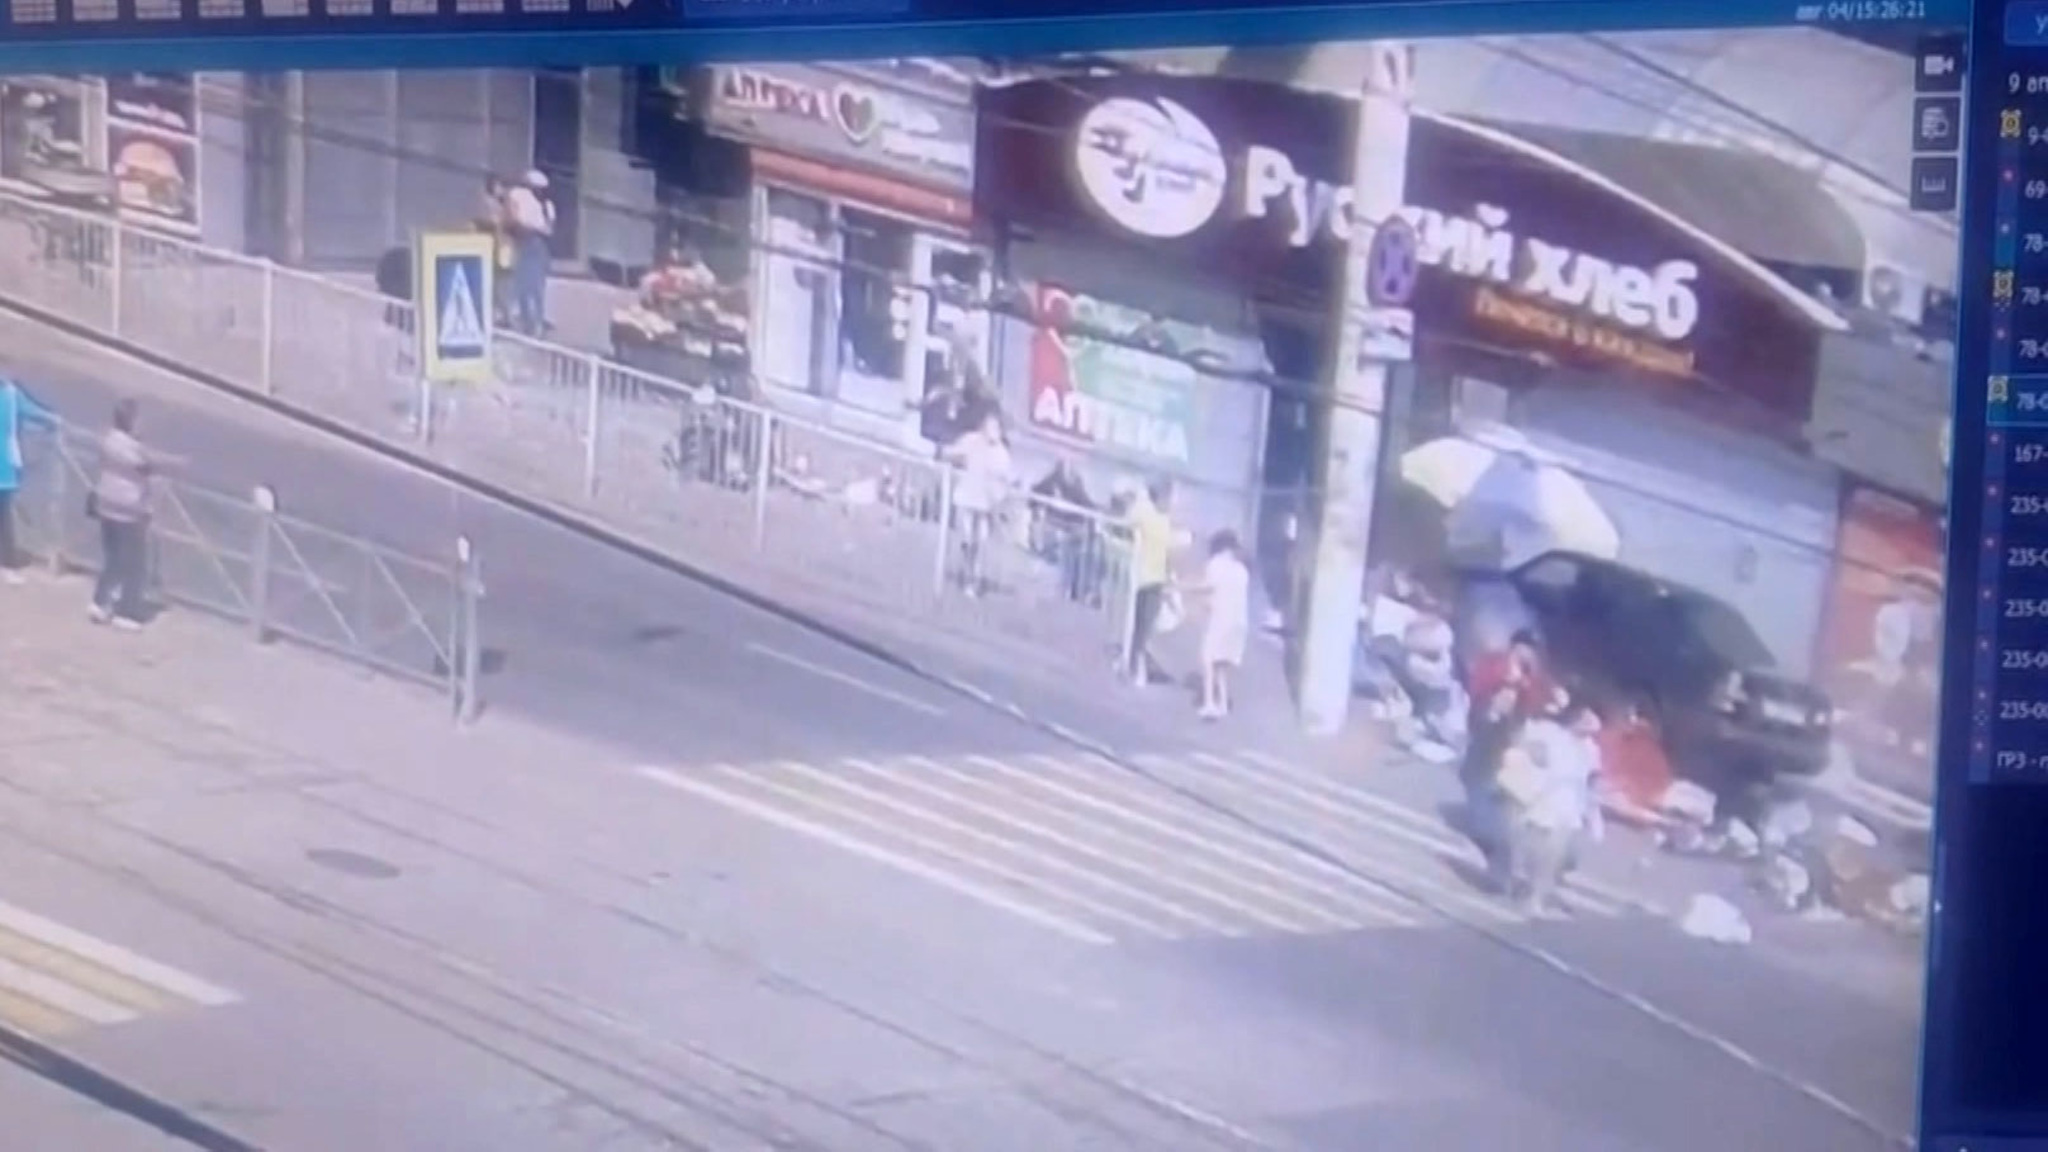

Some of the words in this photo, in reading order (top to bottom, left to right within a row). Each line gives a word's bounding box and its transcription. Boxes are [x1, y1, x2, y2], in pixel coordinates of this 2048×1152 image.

[2008, 71, 2020, 93] 9
[1246, 144, 1512, 283] Русий
[1525, 236, 1699, 340] хлеб
